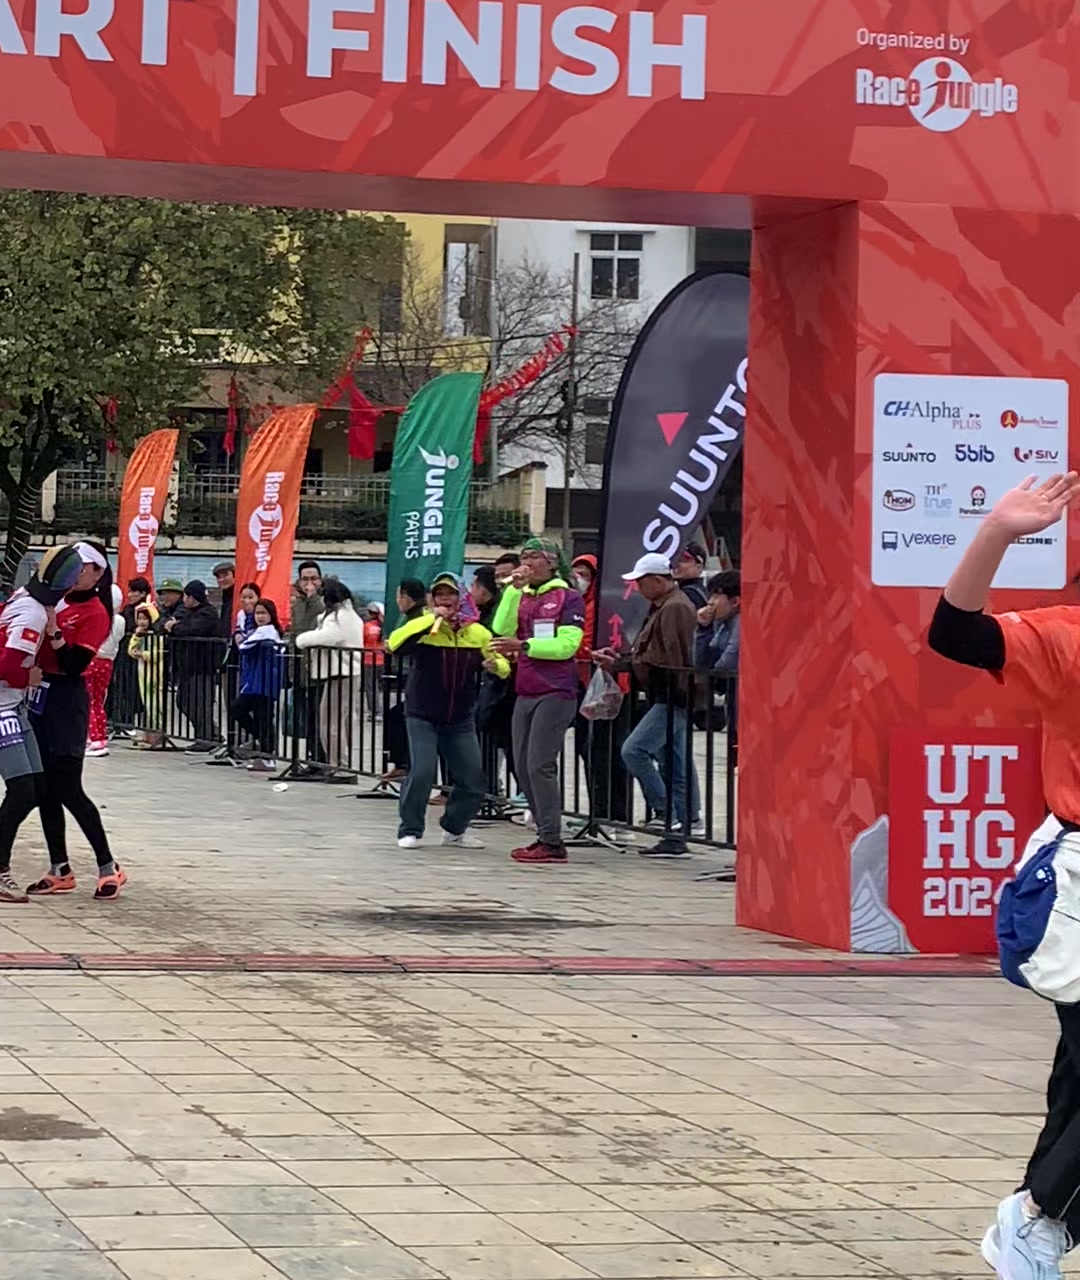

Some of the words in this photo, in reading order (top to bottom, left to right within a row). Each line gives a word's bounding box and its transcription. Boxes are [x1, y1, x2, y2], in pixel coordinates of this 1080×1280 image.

[856, 27, 945, 51] Organized
[949, 30, 970, 56] by
[952, 419, 983, 431] PLUS
[882, 451, 937, 463] SUUNTO
[955, 443, 995, 463] 5bib
[1035, 449, 1059, 461] SIV
[401, 510, 420, 560] PATHS
[901, 532, 957, 548] Vexere
[923, 744, 1019, 805] UT
[923, 809, 1016, 870] HG
